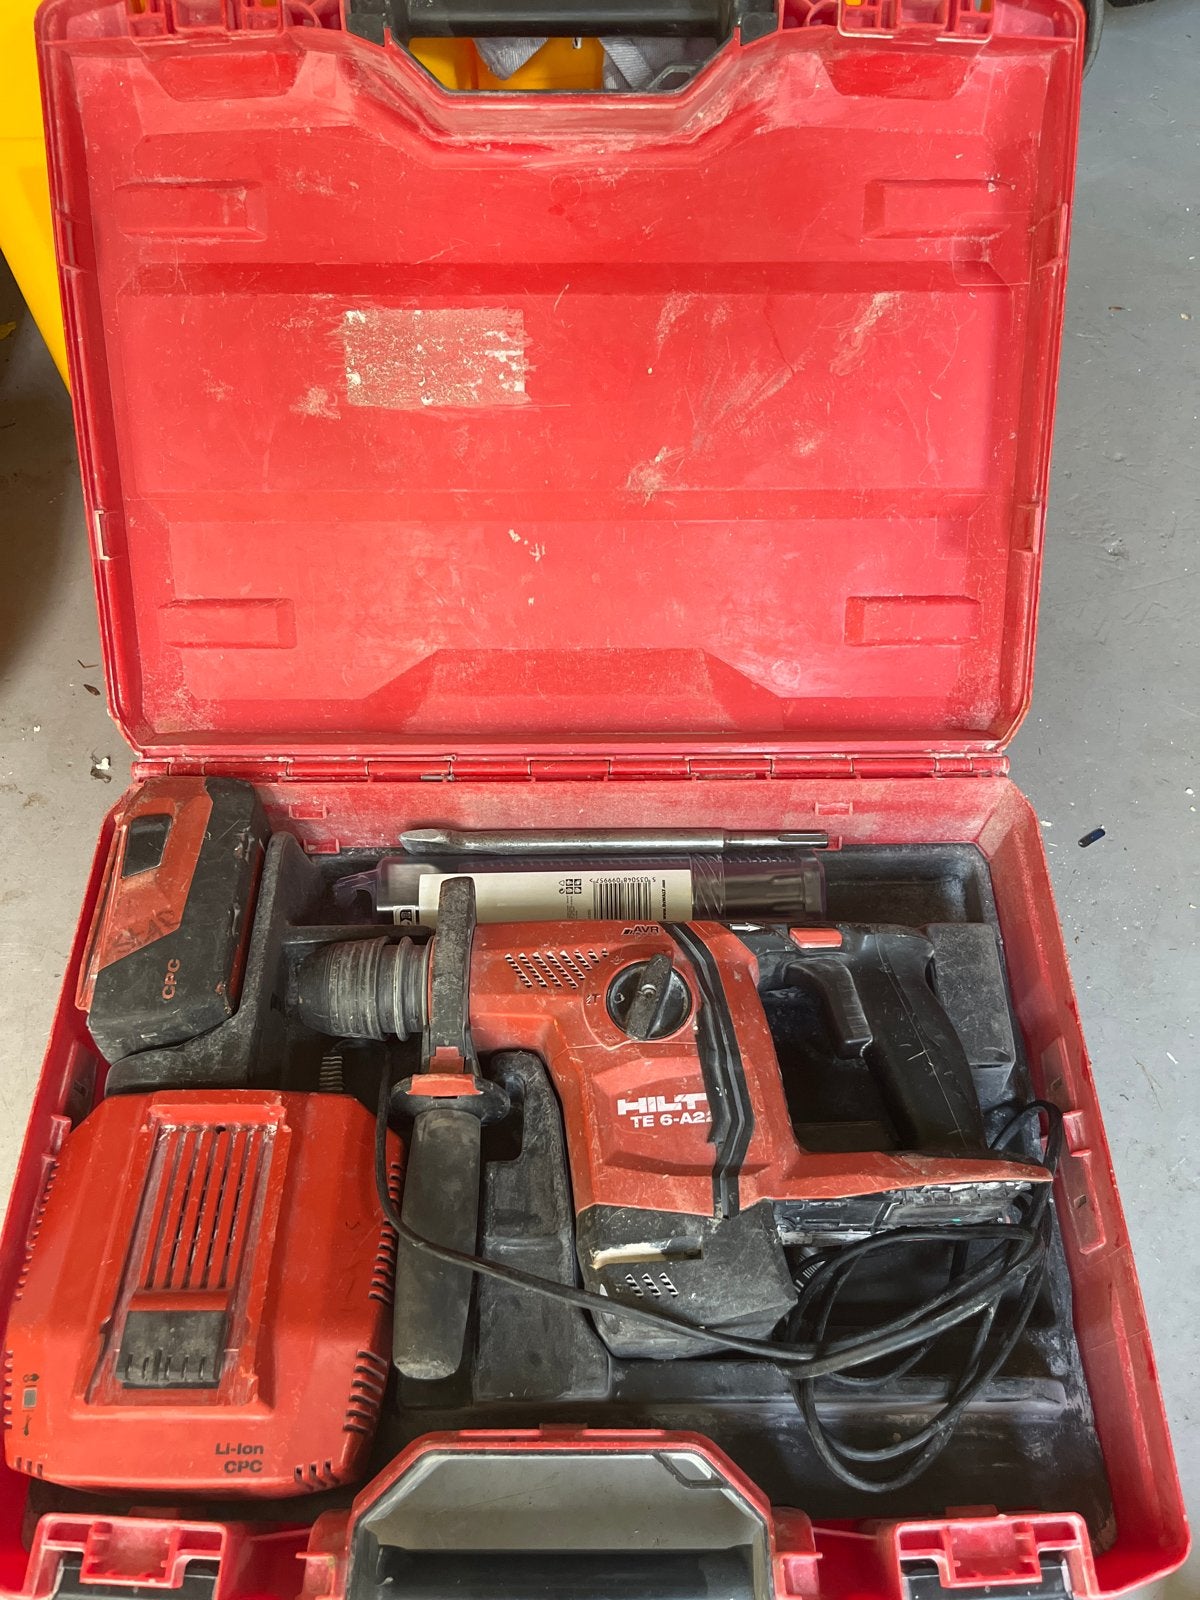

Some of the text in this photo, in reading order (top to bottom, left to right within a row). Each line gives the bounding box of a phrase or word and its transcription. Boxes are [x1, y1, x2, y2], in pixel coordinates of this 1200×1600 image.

[634, 925, 659, 934] AVR
[161, 958, 181, 1000] CPC
[617, 1093, 707, 1115] HILT
[630, 1116, 655, 1128] TE
[216, 1443, 264, 1455] Li-Ion
[224, 1460, 262, 1473] CPC
